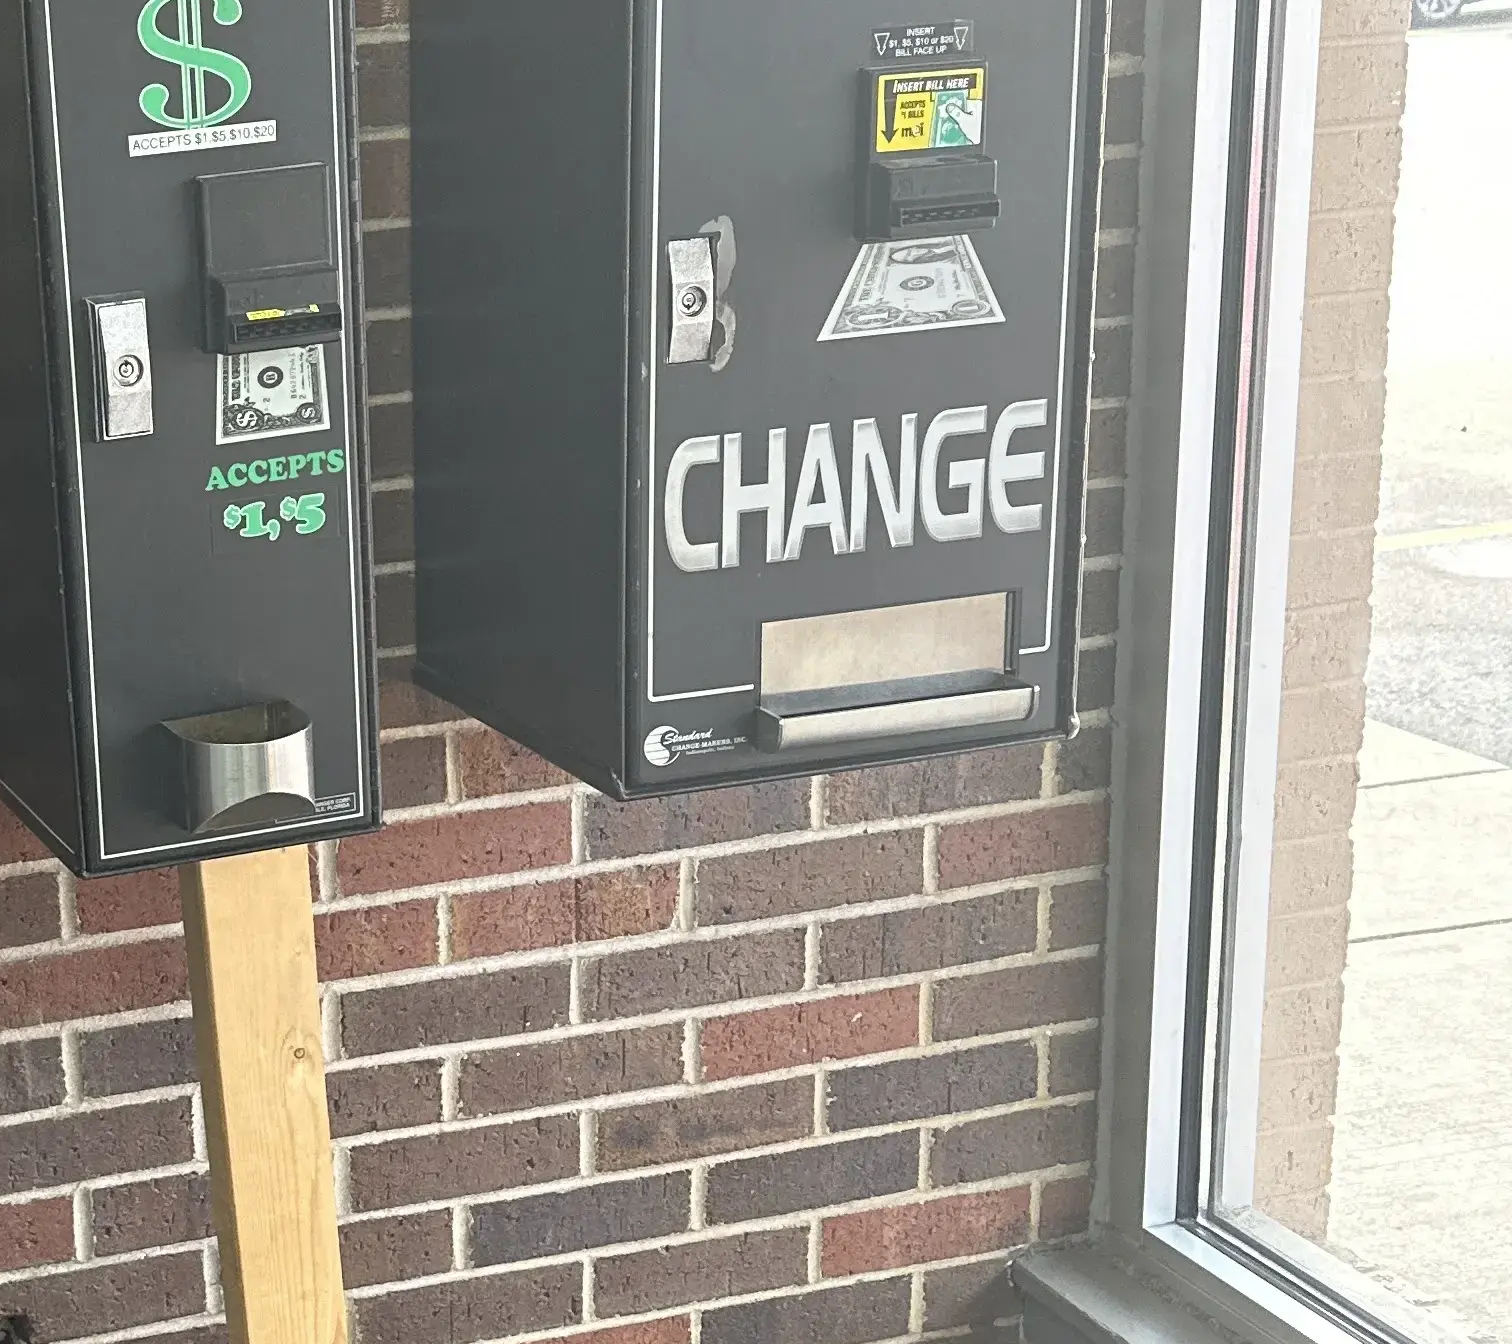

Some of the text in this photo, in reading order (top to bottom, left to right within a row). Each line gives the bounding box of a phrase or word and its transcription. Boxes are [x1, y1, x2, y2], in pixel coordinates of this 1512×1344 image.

[906, 27, 935, 36] INSERT
[915, 37, 929, 46] $10
[895, 45, 947, 57] BILL FACE UP
[925, 80, 944, 91] BILL
[946, 77, 970, 88] HERE
[132, 133, 192, 151] ACCEPTS
[205, 449, 345, 491] ACCEPTS
[664, 398, 1048, 572] CHANGE
